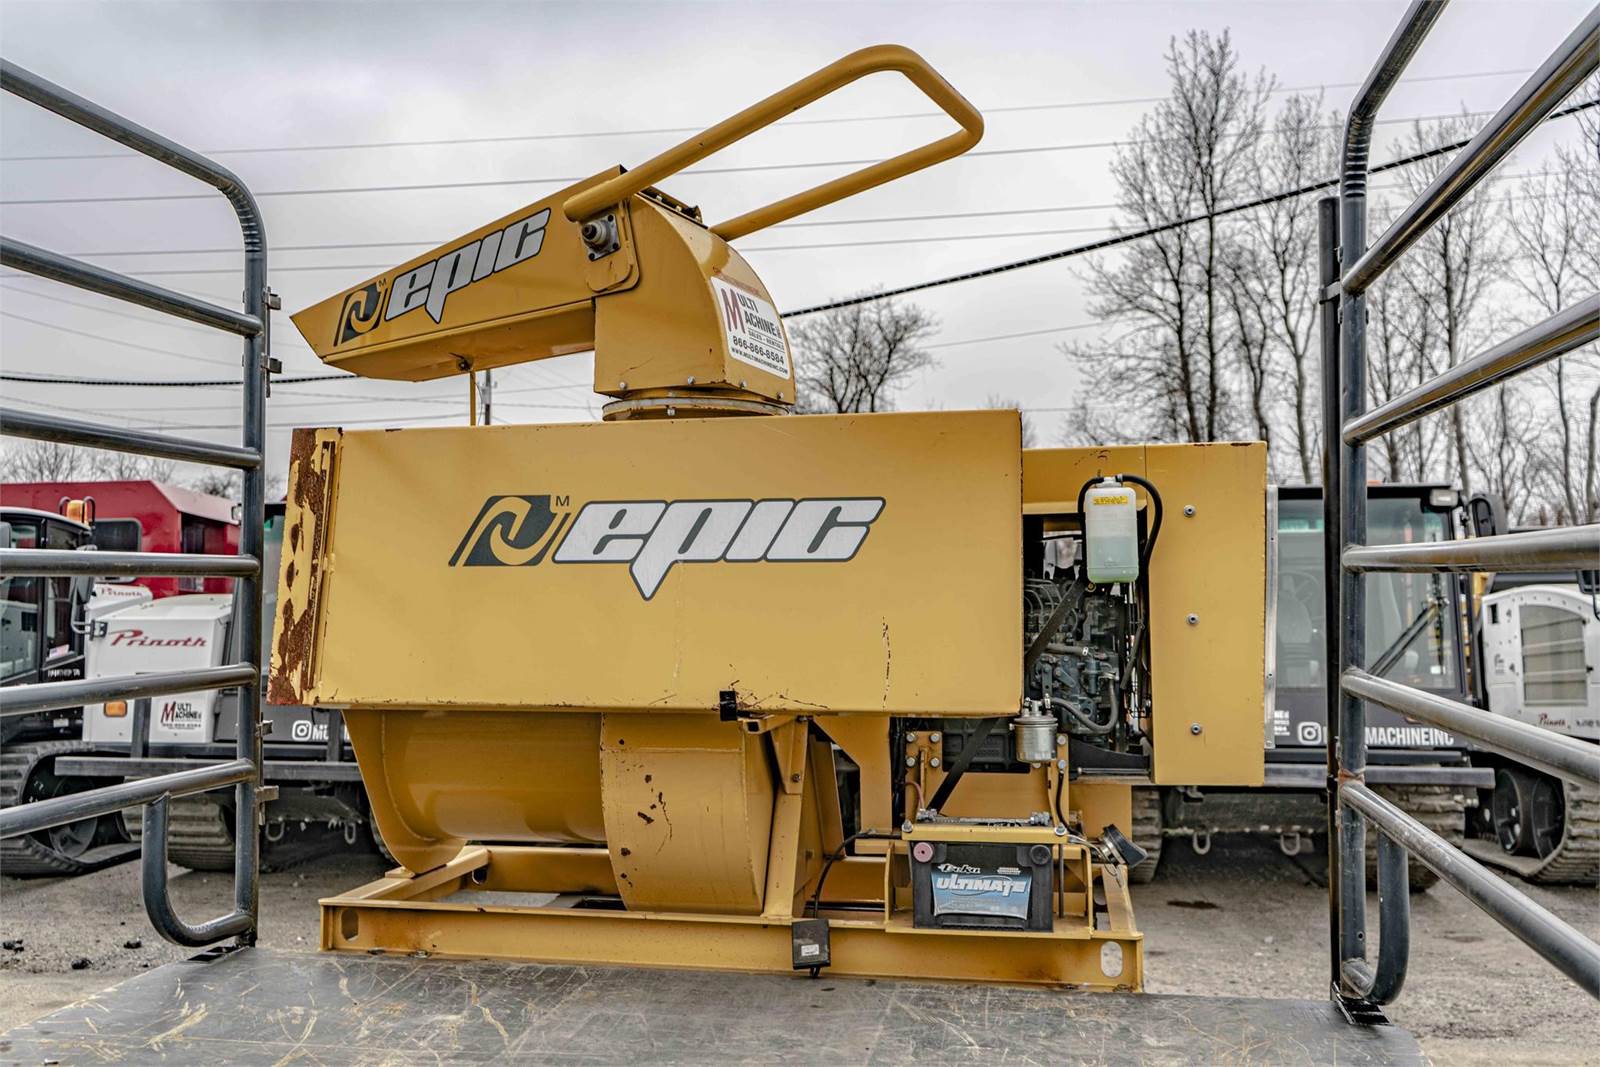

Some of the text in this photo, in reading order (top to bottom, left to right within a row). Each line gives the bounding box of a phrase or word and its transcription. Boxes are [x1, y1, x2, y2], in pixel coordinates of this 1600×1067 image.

[384, 207, 551, 324] epic
[732, 335, 784, 365] 866-866-8584
[551, 496, 886, 602] epic
[108, 629, 208, 647] Prinoth
[1323, 727, 1454, 746] MACHINEINC
